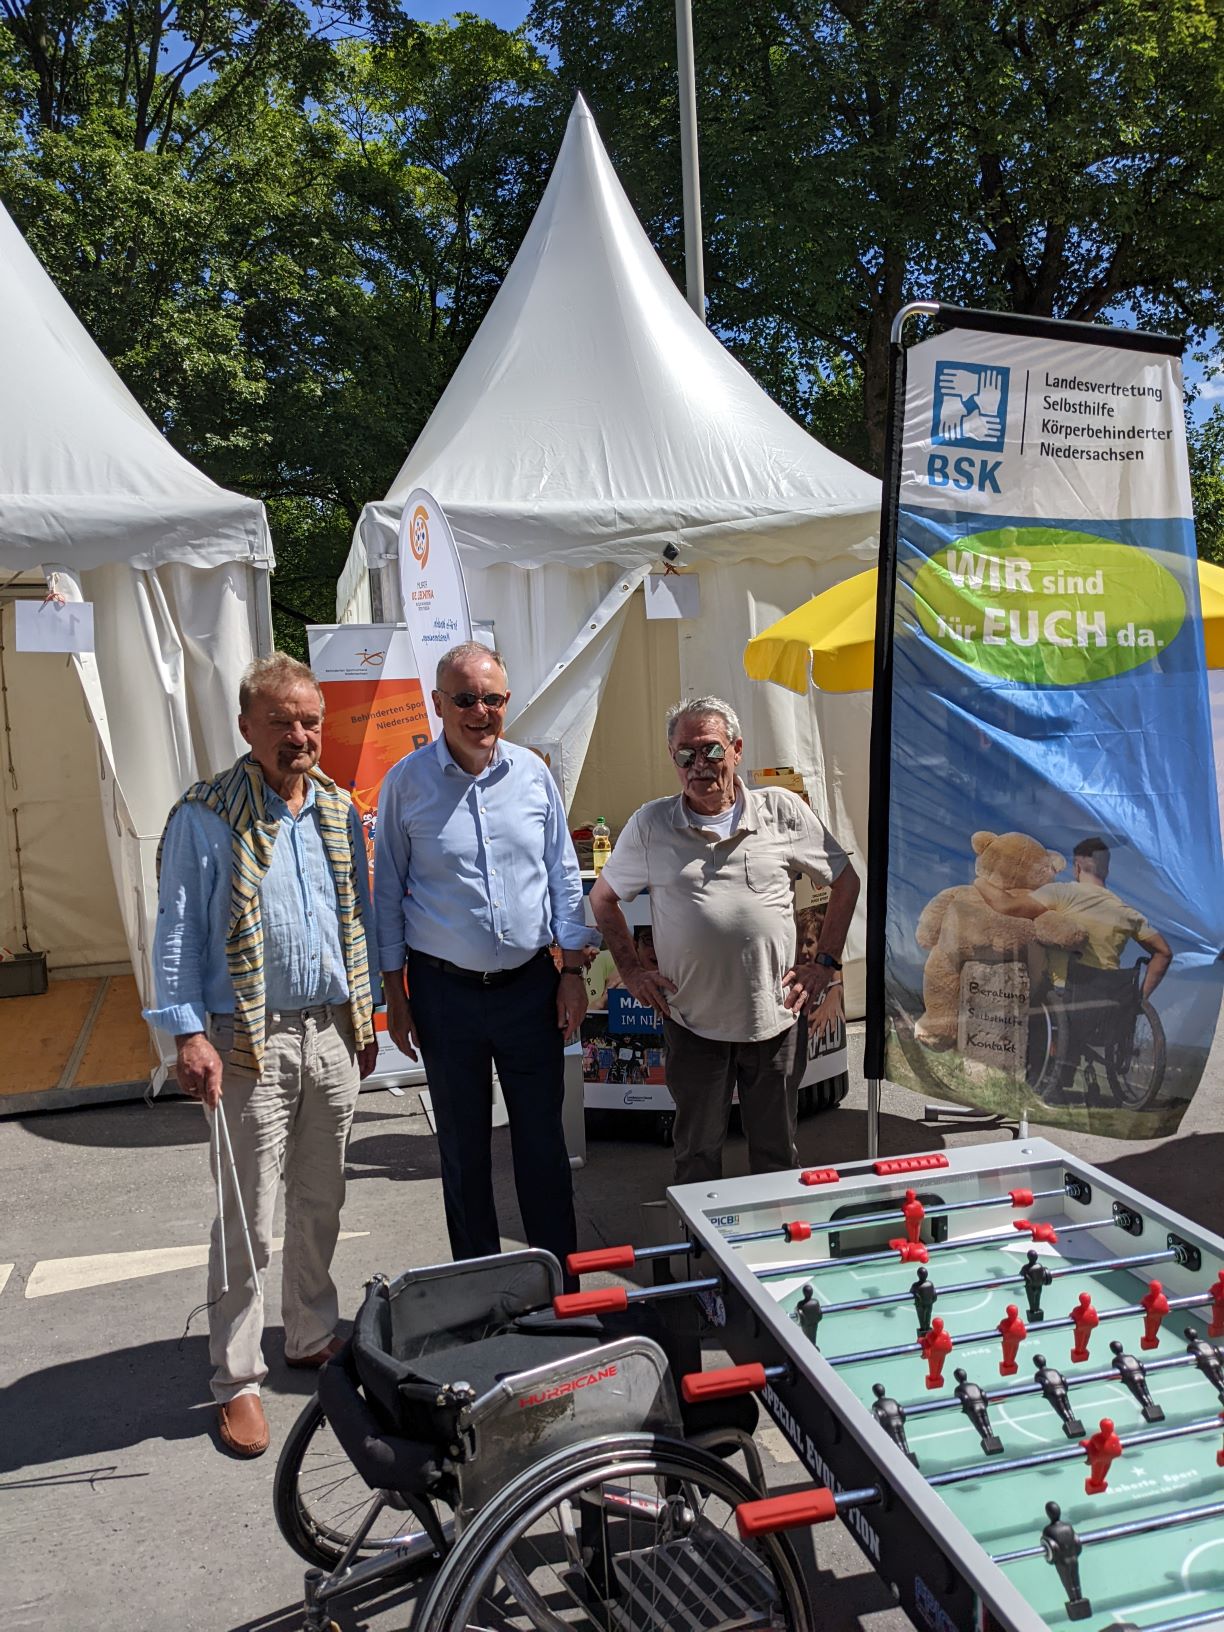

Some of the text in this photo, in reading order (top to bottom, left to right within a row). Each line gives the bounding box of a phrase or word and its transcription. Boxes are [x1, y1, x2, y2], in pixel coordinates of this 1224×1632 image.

[1045, 372, 1163, 402] Landesvertretung
[1043, 395, 1115, 418] Selbsthilfe
[1041, 417, 1174, 442] Körperbehinderter
[1039, 441, 1145, 462] Niedersachsen
[927, 453, 1004, 494] BSK
[946, 549, 1104, 596] WIR sind
[936, 607, 1164, 648] für EUCH da.
[351, 700, 424, 724] Behinderten Spor
[376, 711, 428, 730] Niedersachs
[969, 981, 1026, 1004] Beratung
[621, 1015, 636, 1025] IM
[966, 1033, 1017, 1053] Kontakt
[708, 1215, 734, 1226] PICB
[518, 1365, 618, 1408] HURRICANE
[761, 1383, 881, 1562] SPECIAL EVOLTION
[1162, 1469, 1199, 1483] Sport
